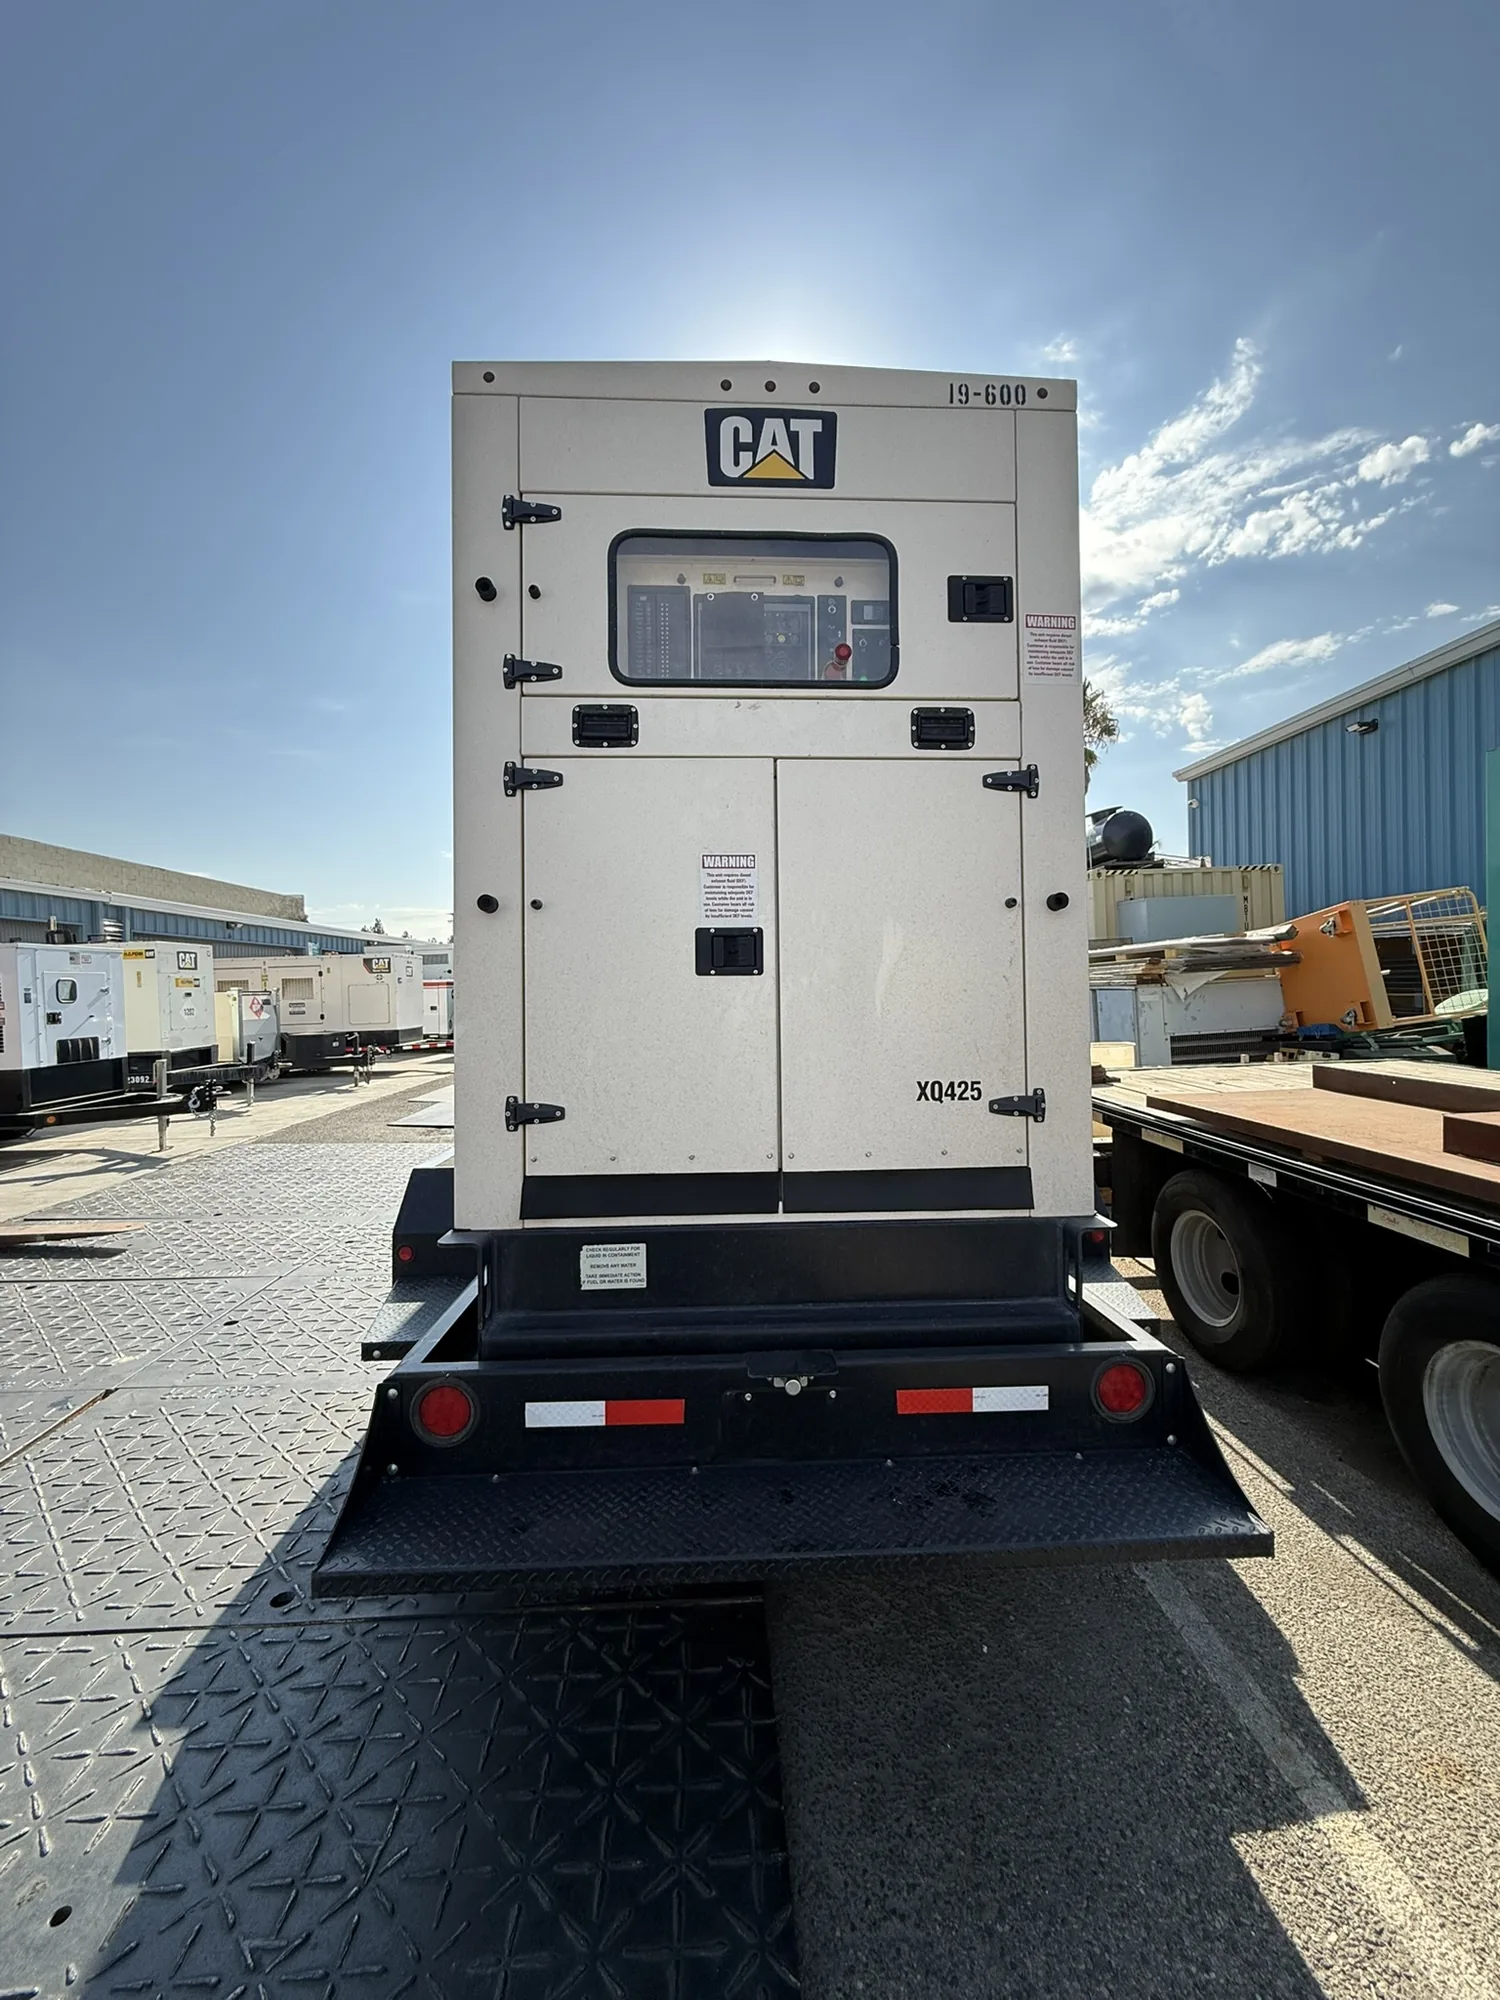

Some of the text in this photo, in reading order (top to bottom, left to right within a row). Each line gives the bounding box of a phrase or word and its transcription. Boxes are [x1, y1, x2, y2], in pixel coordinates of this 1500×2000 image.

[950, 383, 1026, 406] 19-600
[720, 416, 823, 480] CAT
[1026, 615, 1075, 629] WARNING
[703, 855, 755, 868] WARNING
[178, 952, 196, 969] CAT
[372, 958, 390, 969] CAT
[916, 1080, 982, 1104] XQ425
